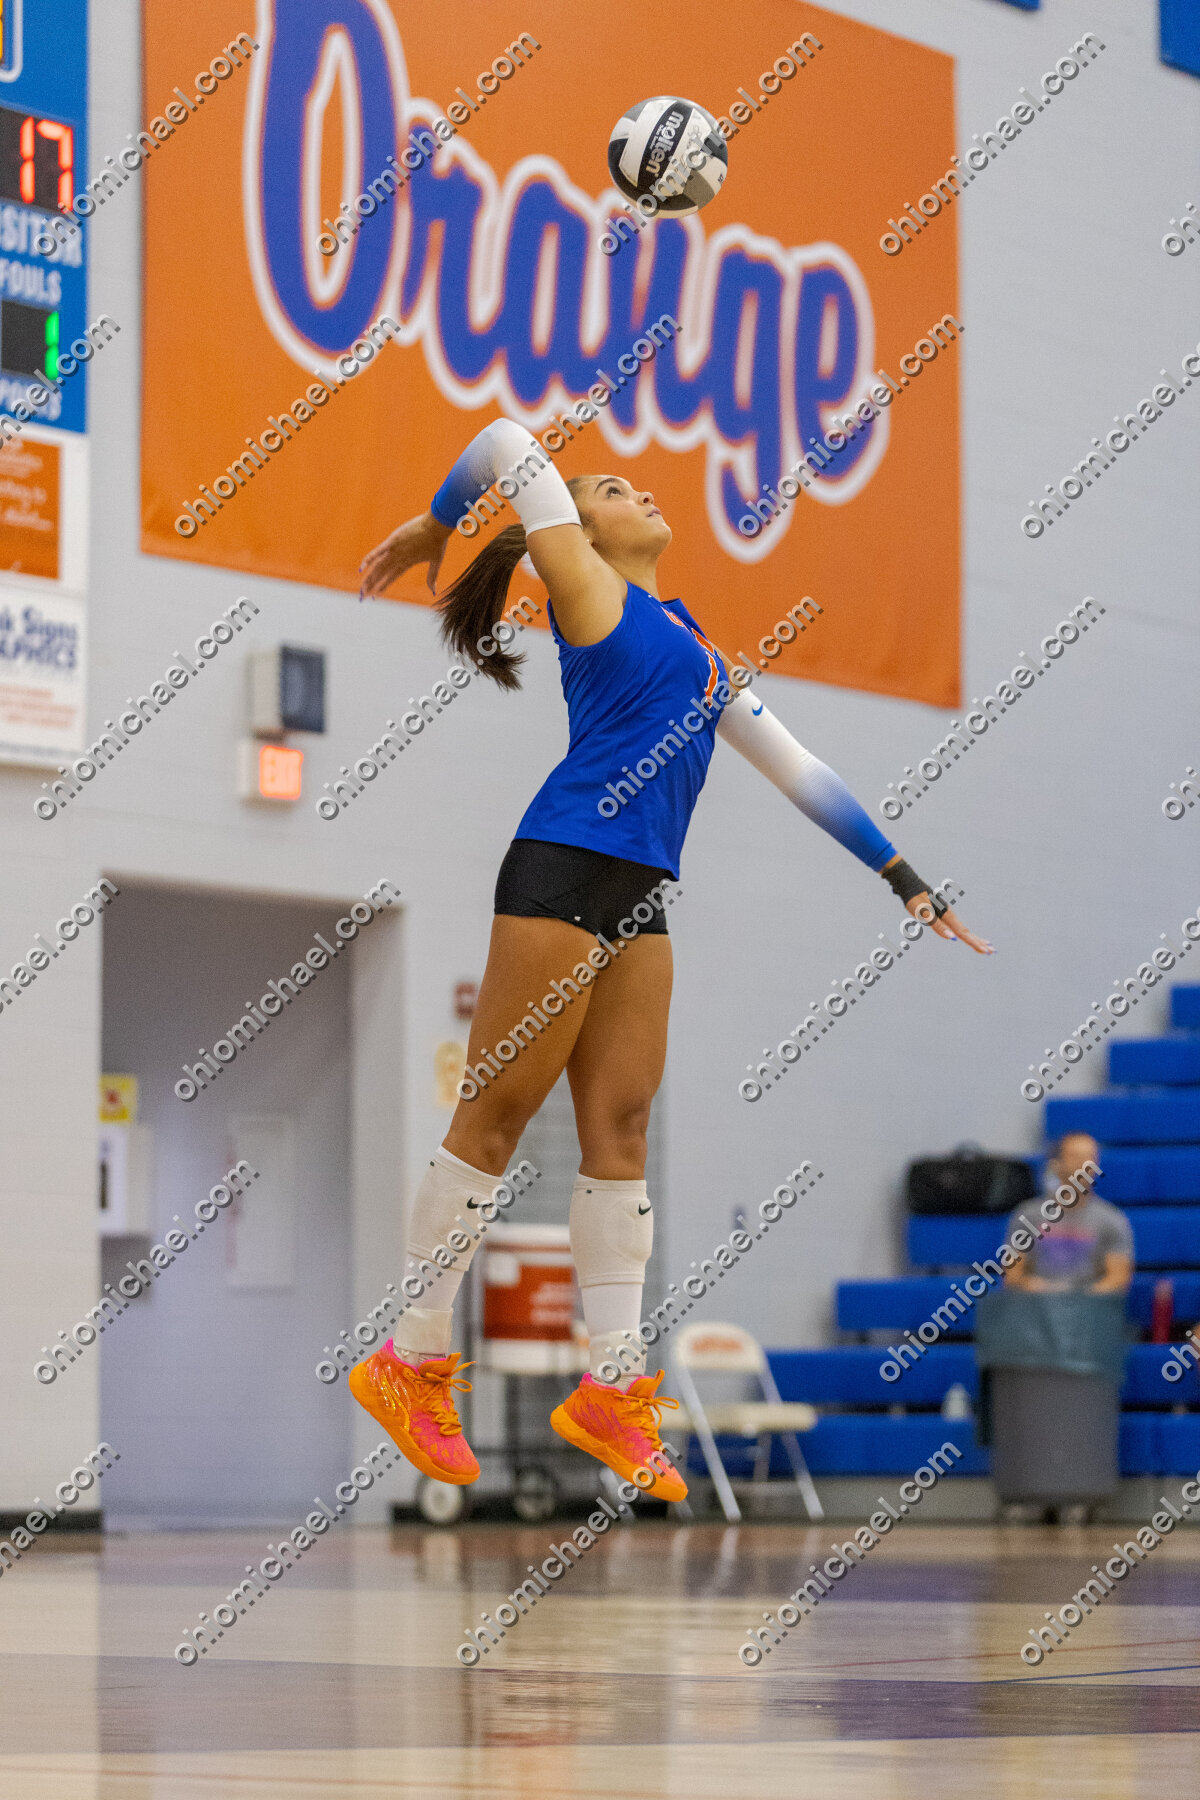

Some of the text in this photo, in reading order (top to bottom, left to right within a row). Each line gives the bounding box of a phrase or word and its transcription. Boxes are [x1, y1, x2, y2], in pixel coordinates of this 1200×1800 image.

[20, 116, 73, 214] 17
[645, 111, 684, 175] molten
[243, 0, 889, 561] Orange
[44, 311, 59, 380] 1
